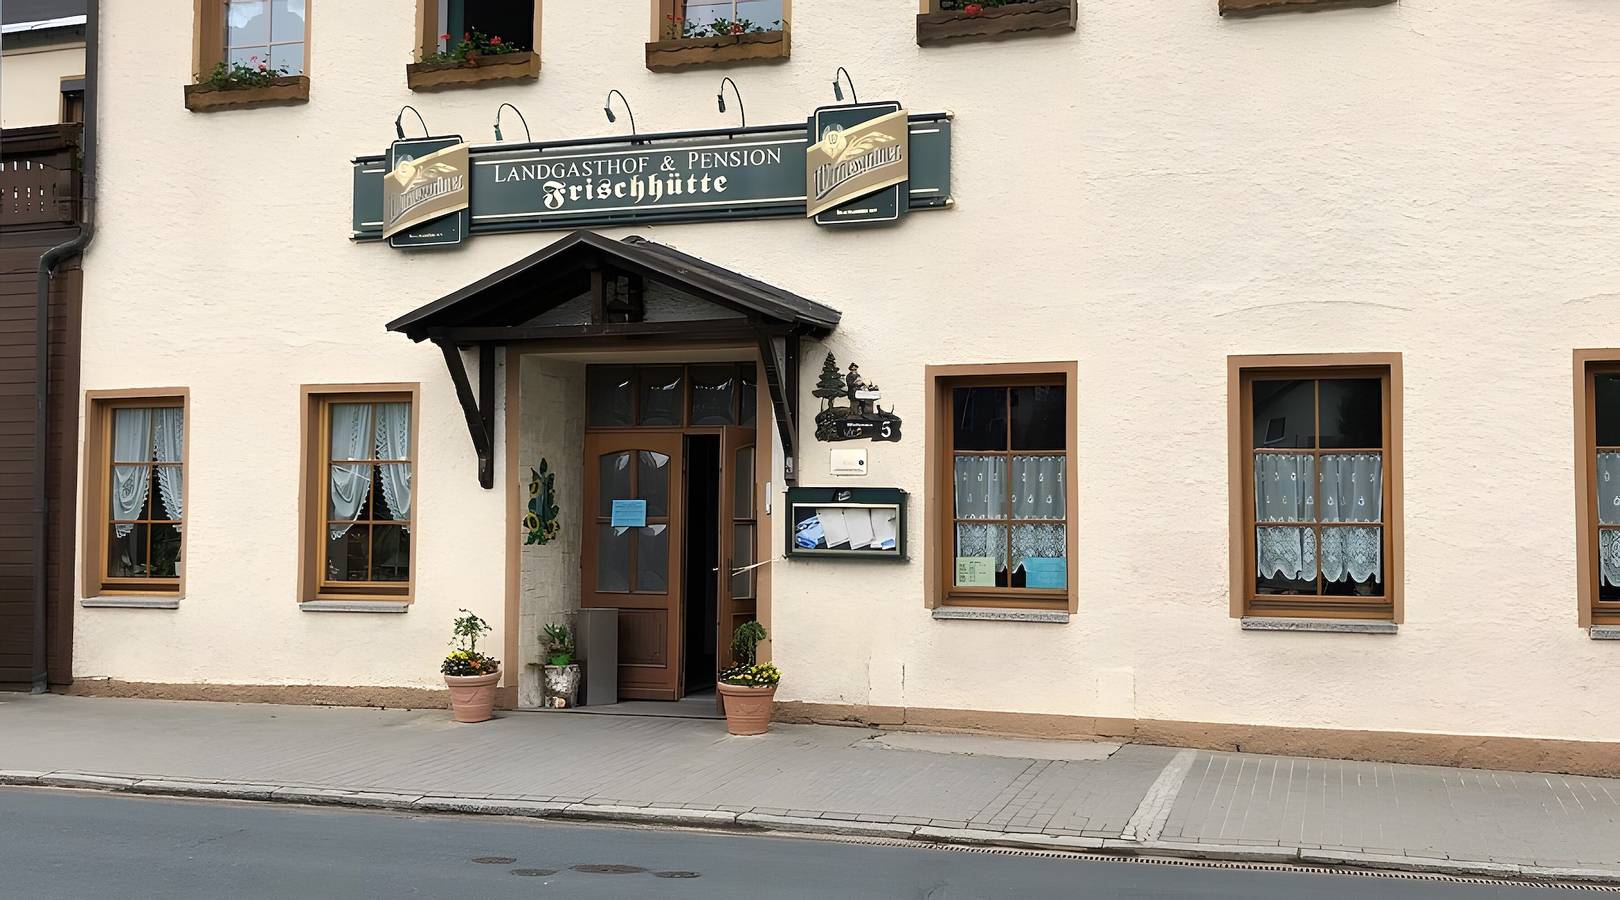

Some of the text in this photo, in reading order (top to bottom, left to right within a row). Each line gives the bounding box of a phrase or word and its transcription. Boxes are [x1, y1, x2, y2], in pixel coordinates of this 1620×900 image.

[494, 147, 781, 183] LANDGASTHOF & PENSION
[542, 172, 729, 210] Frischhütte
[880, 420, 892, 438] 5
